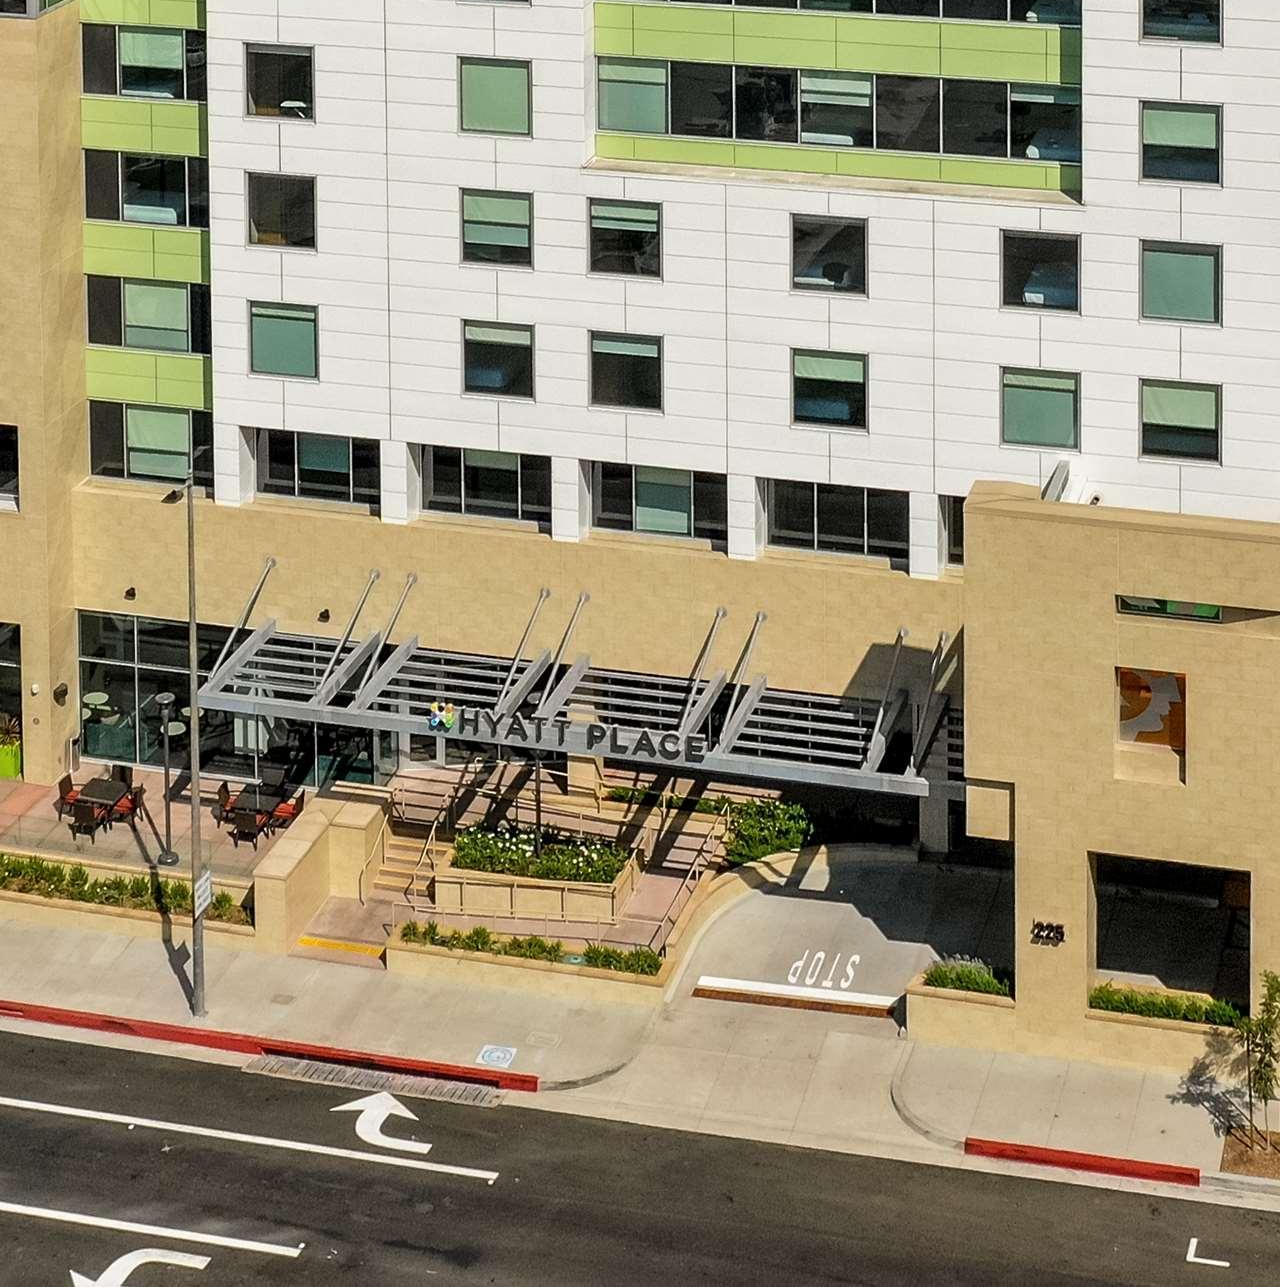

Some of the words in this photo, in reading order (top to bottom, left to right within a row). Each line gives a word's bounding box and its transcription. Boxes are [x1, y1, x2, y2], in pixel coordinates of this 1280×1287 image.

[458, 705, 570, 747] HYATT
[586, 723, 708, 762] PLACE
[1032, 920, 1065, 942] 225
[787, 949, 860, 989] STOP
